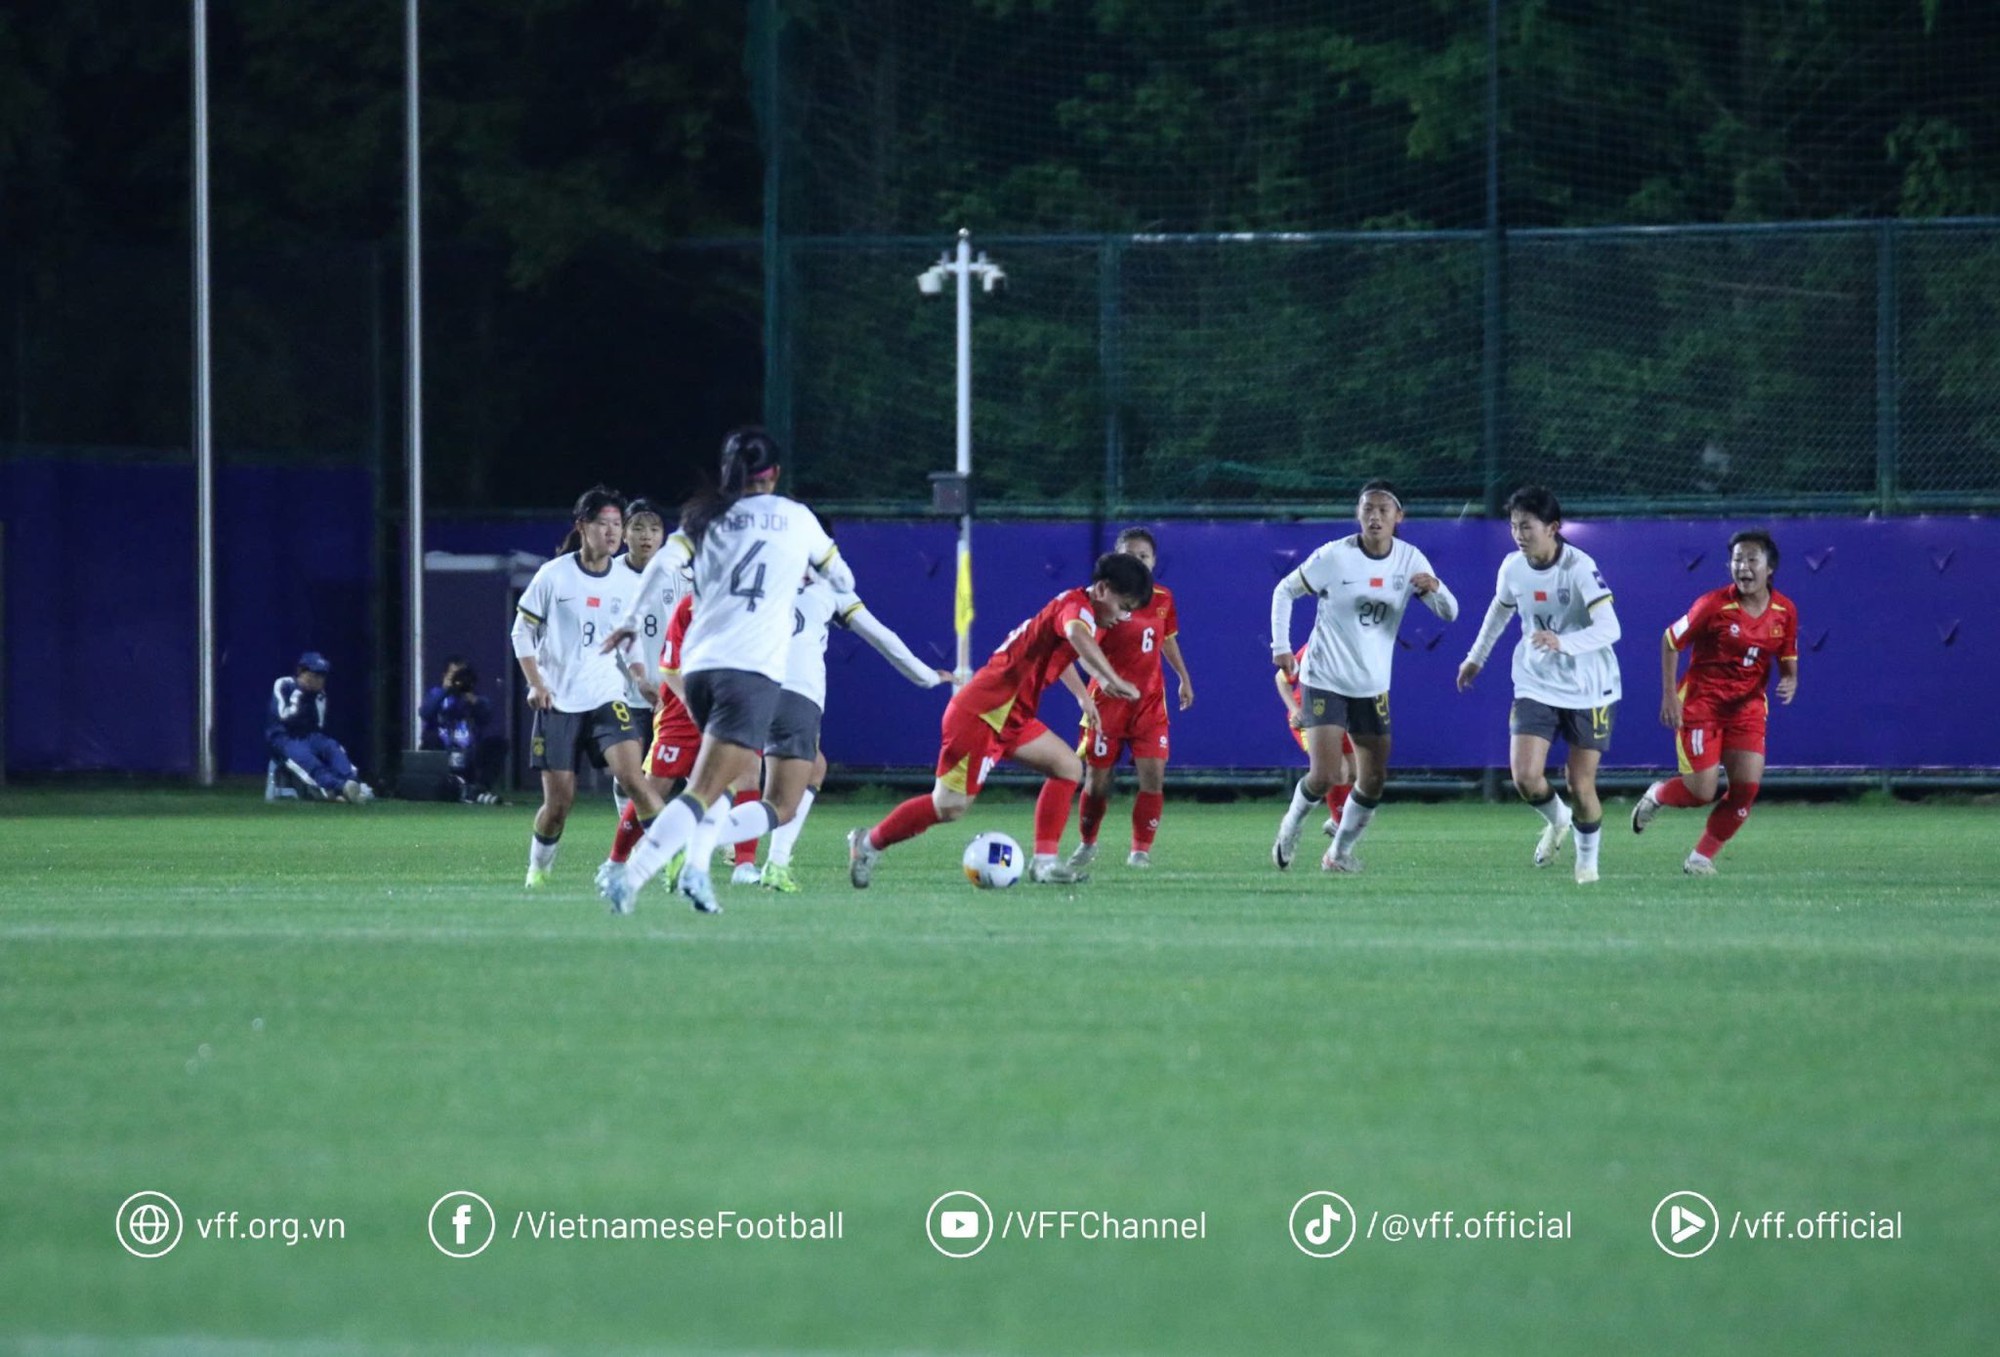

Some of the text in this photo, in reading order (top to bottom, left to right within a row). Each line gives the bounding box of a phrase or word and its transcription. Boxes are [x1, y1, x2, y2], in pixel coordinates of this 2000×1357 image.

[730, 540, 767, 613] 4
[645, 614, 657, 637] 8
[1359, 602, 1387, 626] 20
[583, 622, 595, 647] 8
[1141, 627, 1155, 653] 6
[612, 701, 630, 722] 8
[1691, 729, 1704, 756] 11
